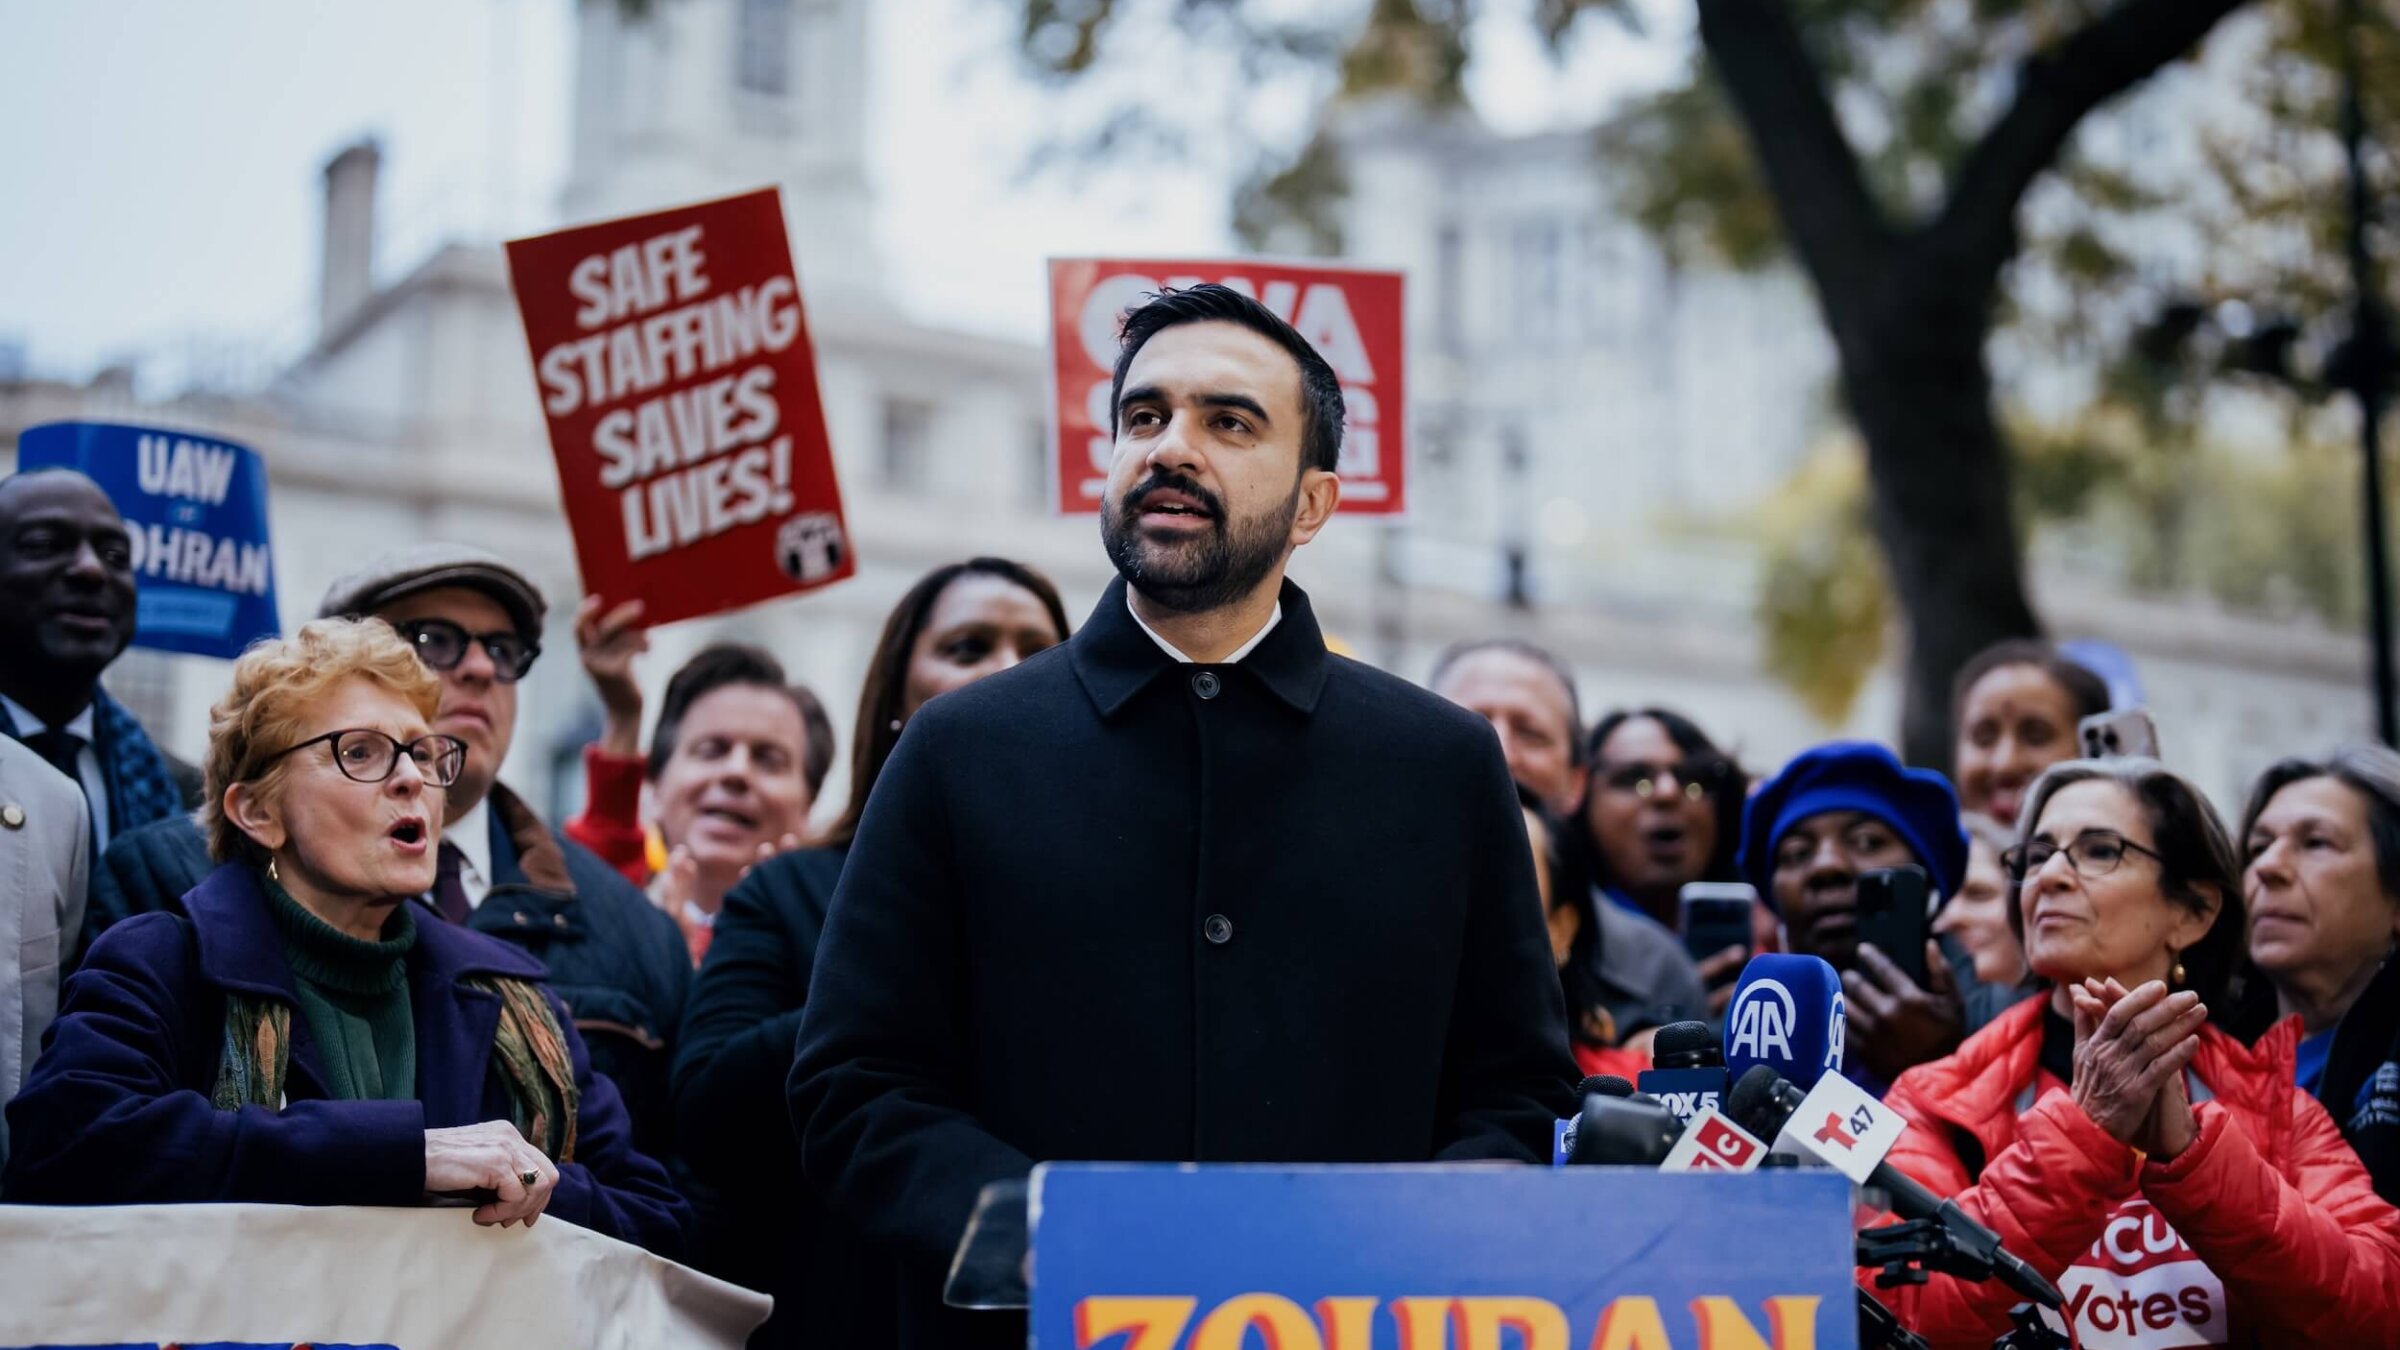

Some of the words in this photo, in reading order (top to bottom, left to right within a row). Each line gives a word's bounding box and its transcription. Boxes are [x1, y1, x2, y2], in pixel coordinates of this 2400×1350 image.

[569, 226, 709, 328] SAFE
[540, 276, 801, 417] STAFFING
[138, 434, 235, 506] UAW
[592, 364, 779, 489] SAVES
[620, 435, 794, 561] LIVES!
[123, 518, 268, 596] OHRAN
[1730, 1000, 1793, 1060] AA
[1850, 1104, 1873, 1135] 47
